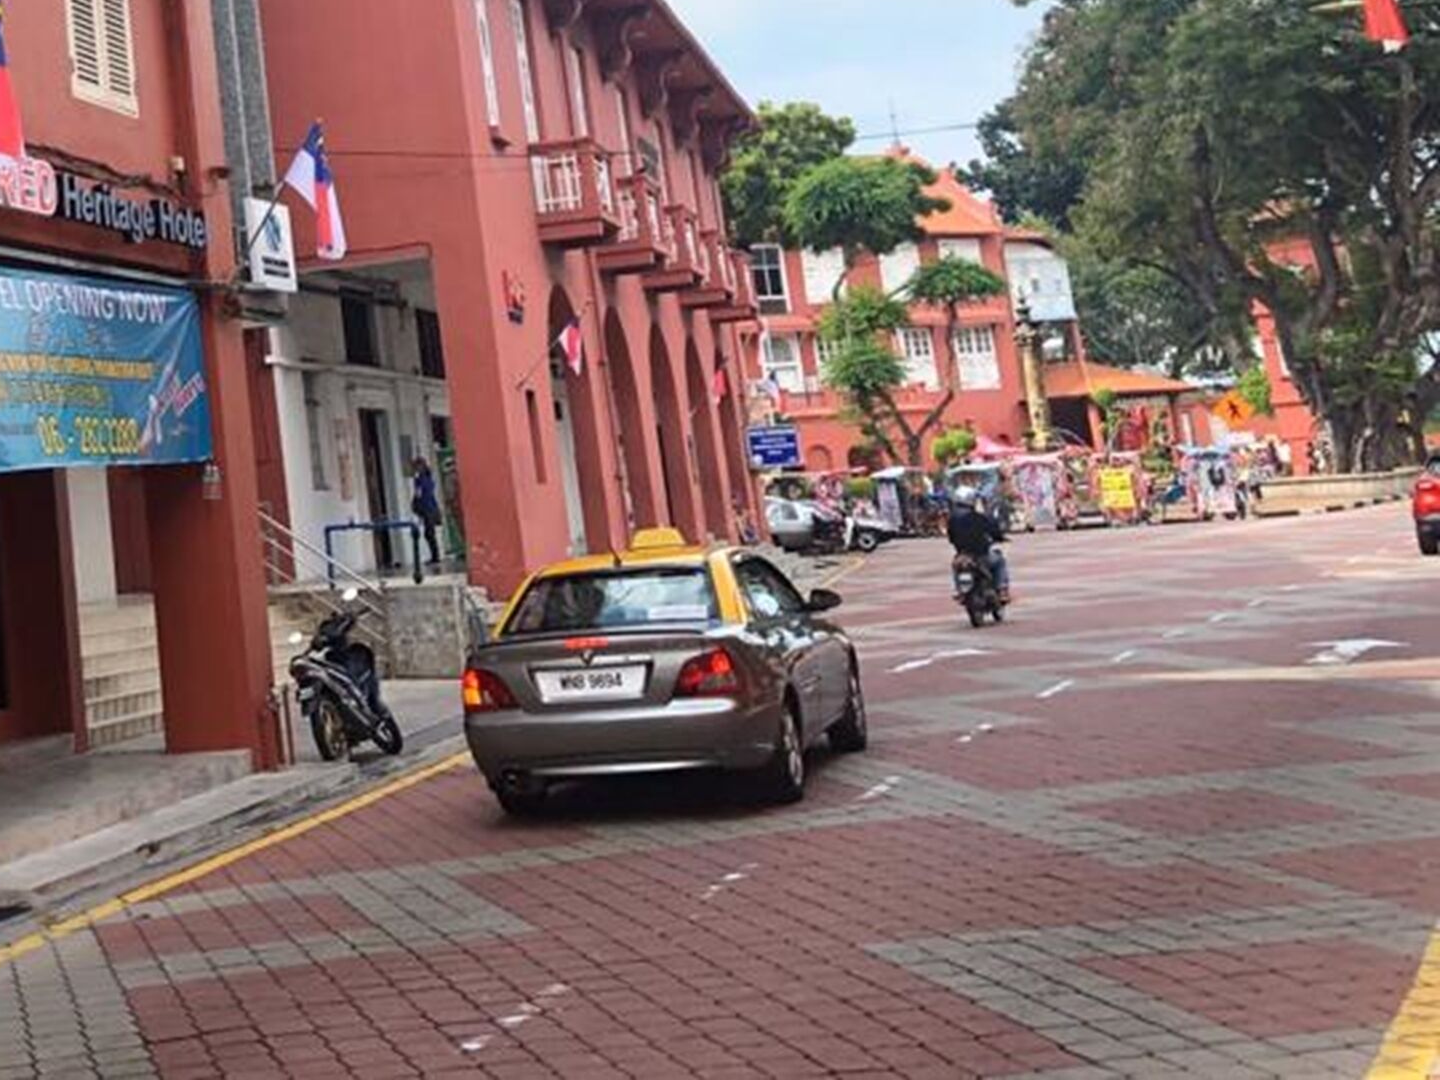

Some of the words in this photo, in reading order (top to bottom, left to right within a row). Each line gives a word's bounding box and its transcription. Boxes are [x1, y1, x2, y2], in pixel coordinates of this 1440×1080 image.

[63, 171, 156, 243] Heritage
[25, 279, 115, 320] OPENING
[118, 288, 167, 324] NOW
